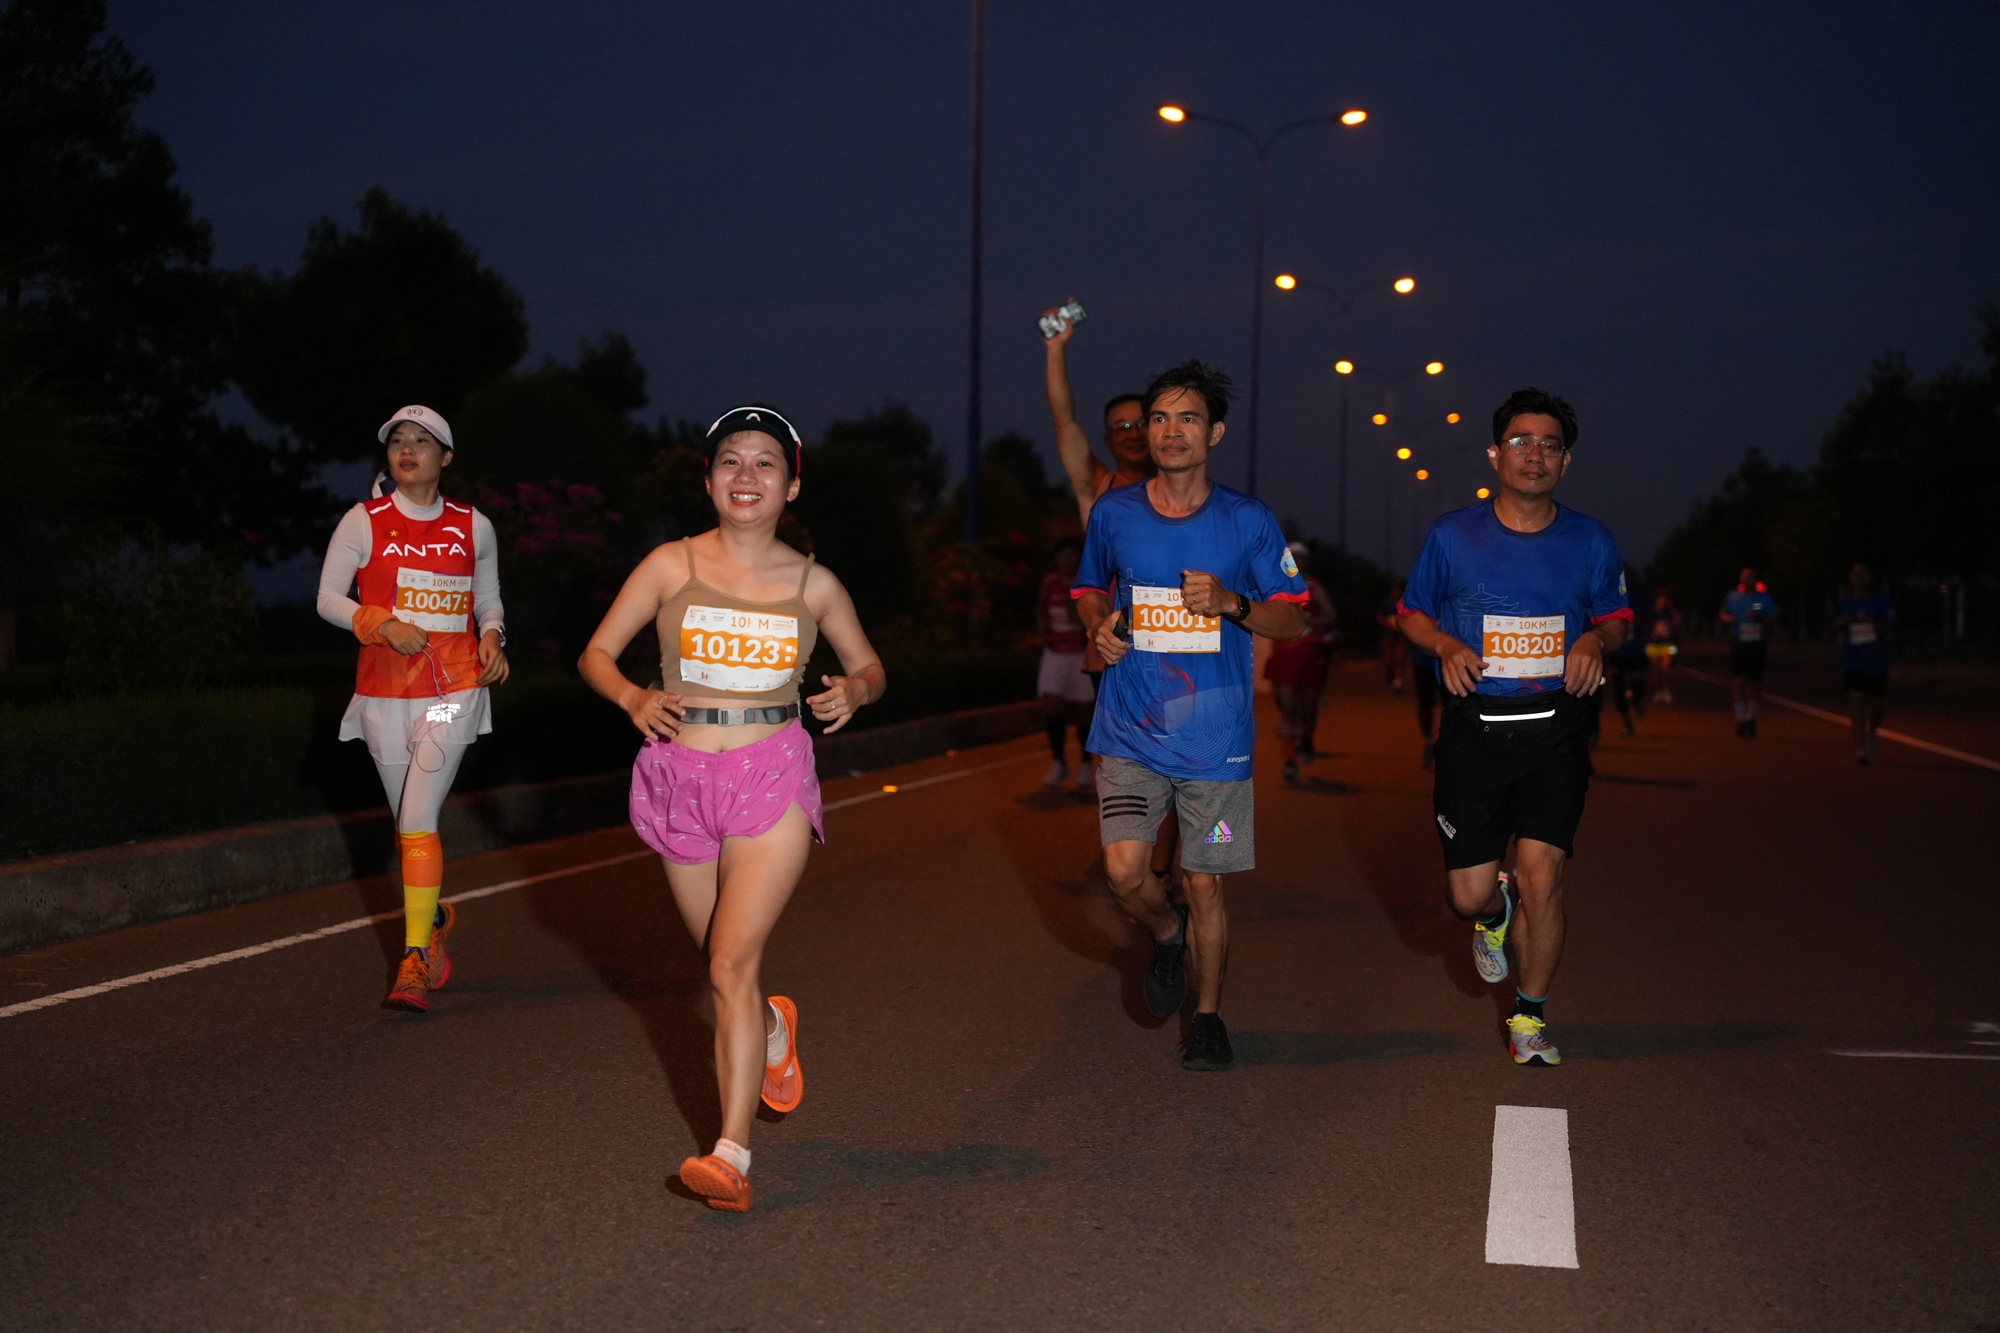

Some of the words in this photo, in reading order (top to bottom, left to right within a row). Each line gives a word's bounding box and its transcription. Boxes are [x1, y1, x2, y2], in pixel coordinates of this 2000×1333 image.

[383, 542, 466, 557] ANTA
[432, 579, 456, 587] 10KM
[404, 590, 462, 611] 10047
[1167, 592, 1183, 602] 10
[1519, 621, 1547, 630] 10KM
[691, 633, 780, 665] 10123
[1491, 635, 1555, 655] 10820
